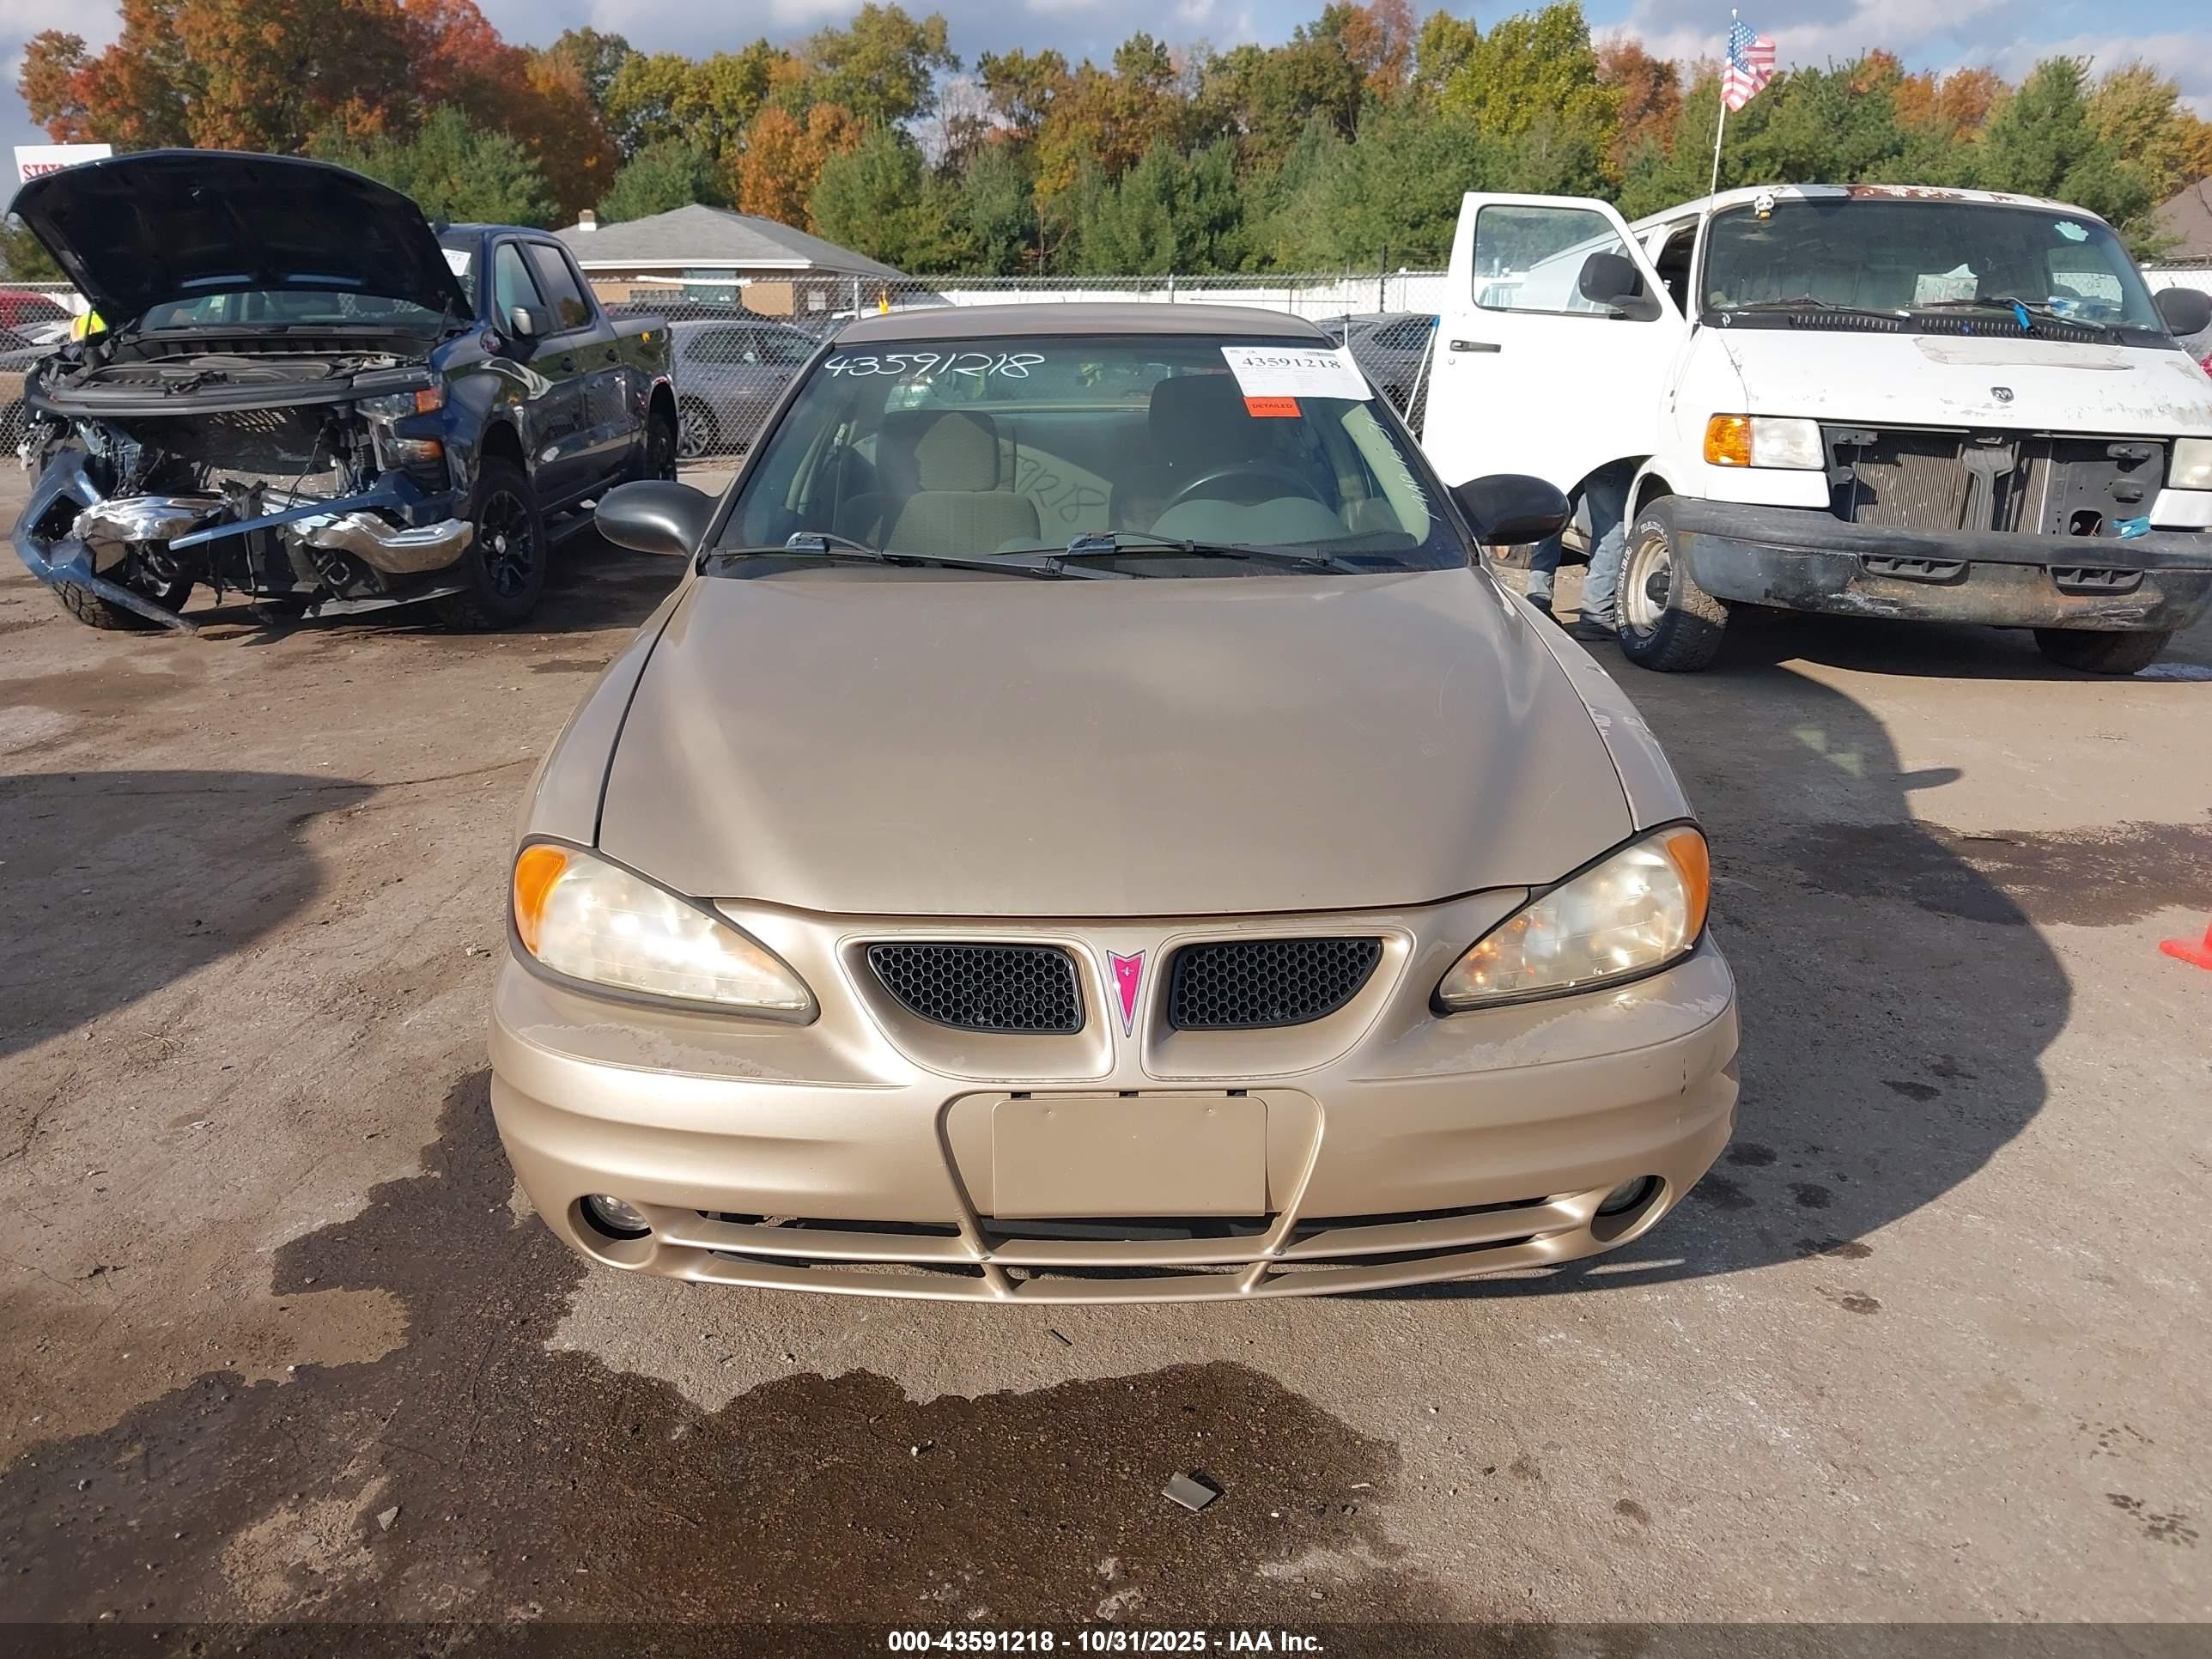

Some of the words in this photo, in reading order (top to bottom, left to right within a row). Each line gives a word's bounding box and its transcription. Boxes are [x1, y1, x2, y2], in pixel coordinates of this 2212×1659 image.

[22, 164, 64, 179] STAT
[824, 353, 1045, 378] 43591218
[1242, 357, 1341, 369] 43591218
